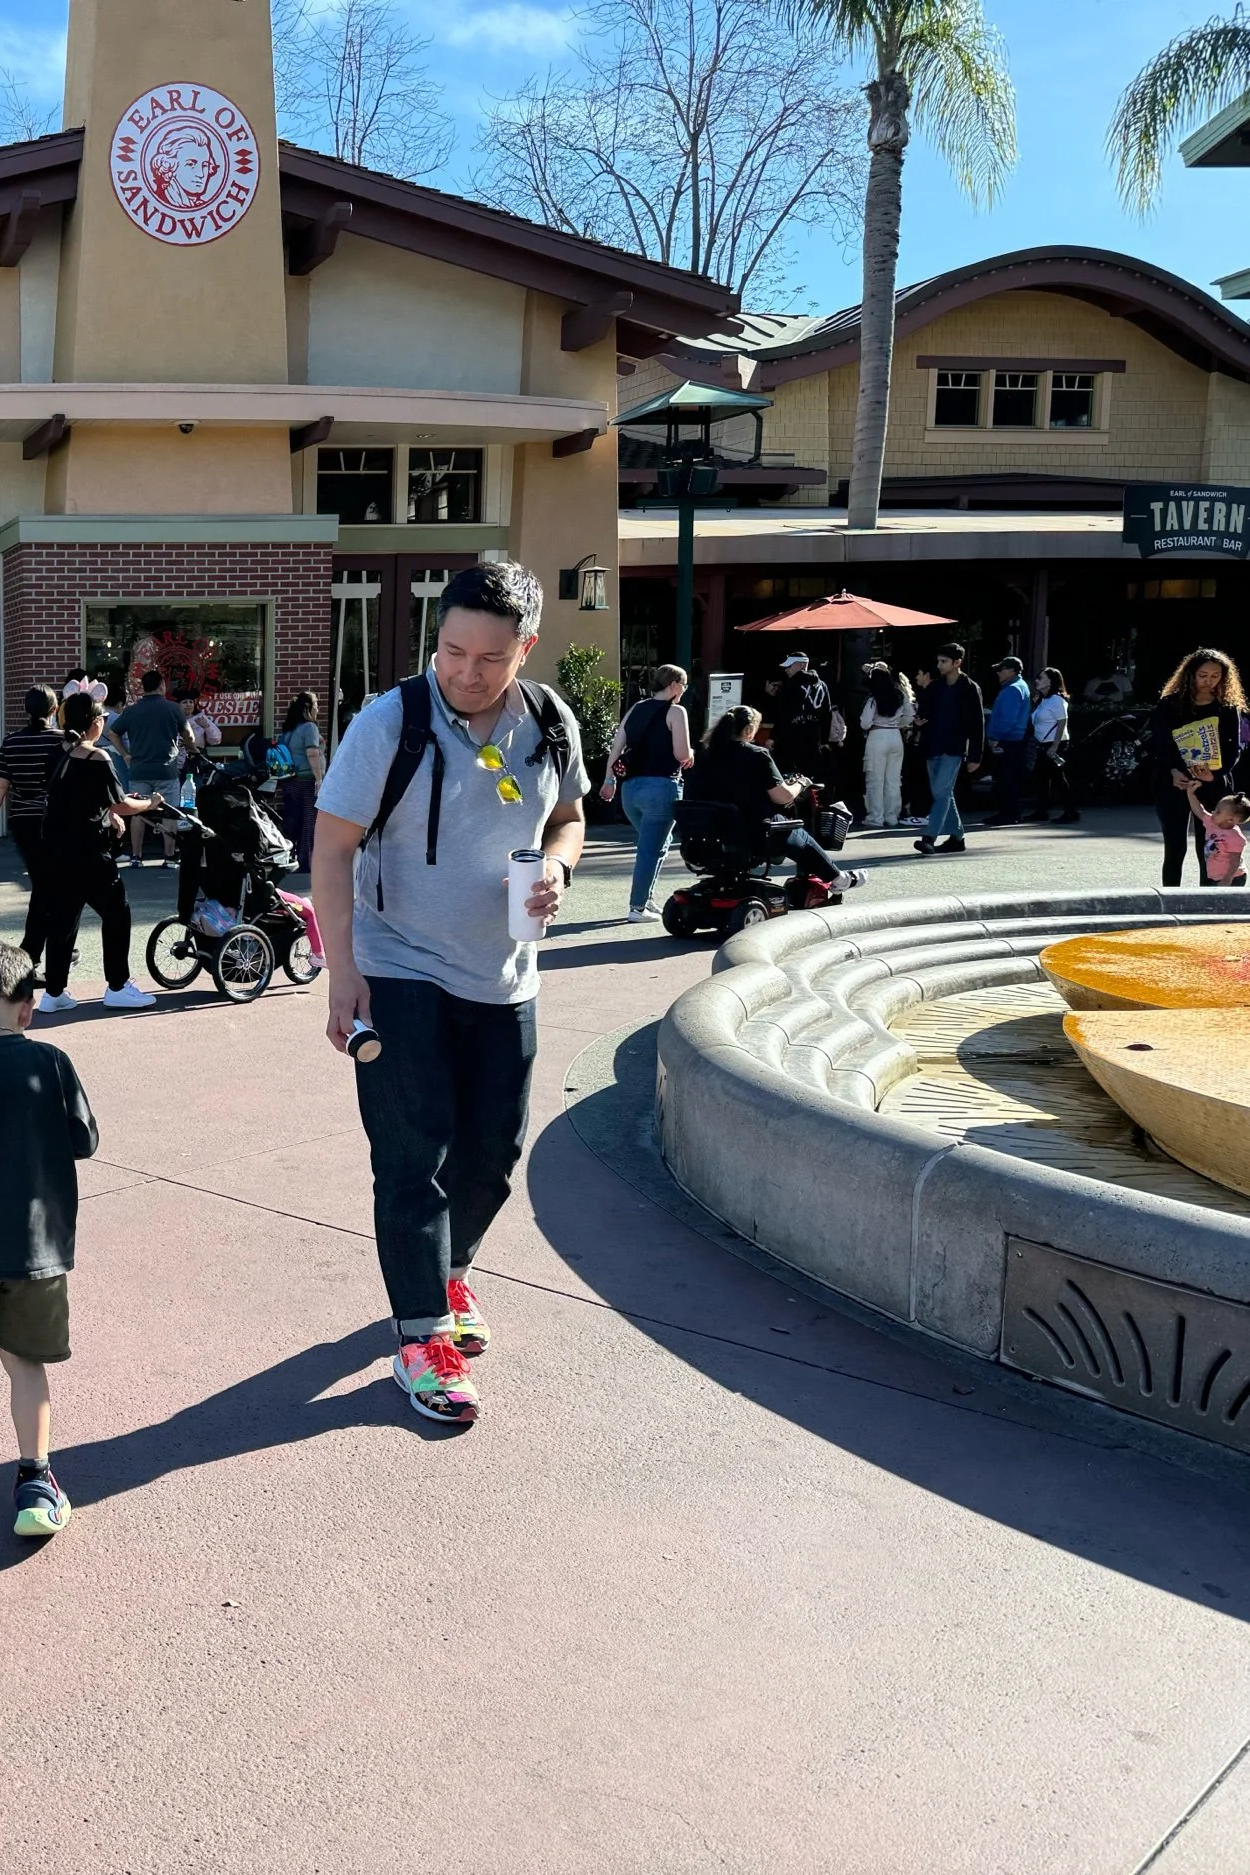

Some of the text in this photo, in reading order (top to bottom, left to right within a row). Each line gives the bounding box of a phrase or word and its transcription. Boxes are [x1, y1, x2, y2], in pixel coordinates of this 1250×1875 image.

[127, 89, 250, 144] EARL OF
[117, 169, 250, 240] SANDWICH
[1187, 490, 1193, 498] of
[1150, 501, 1246, 534] TAVERN
[1154, 536, 1243, 552] RESTAURANT BAR
